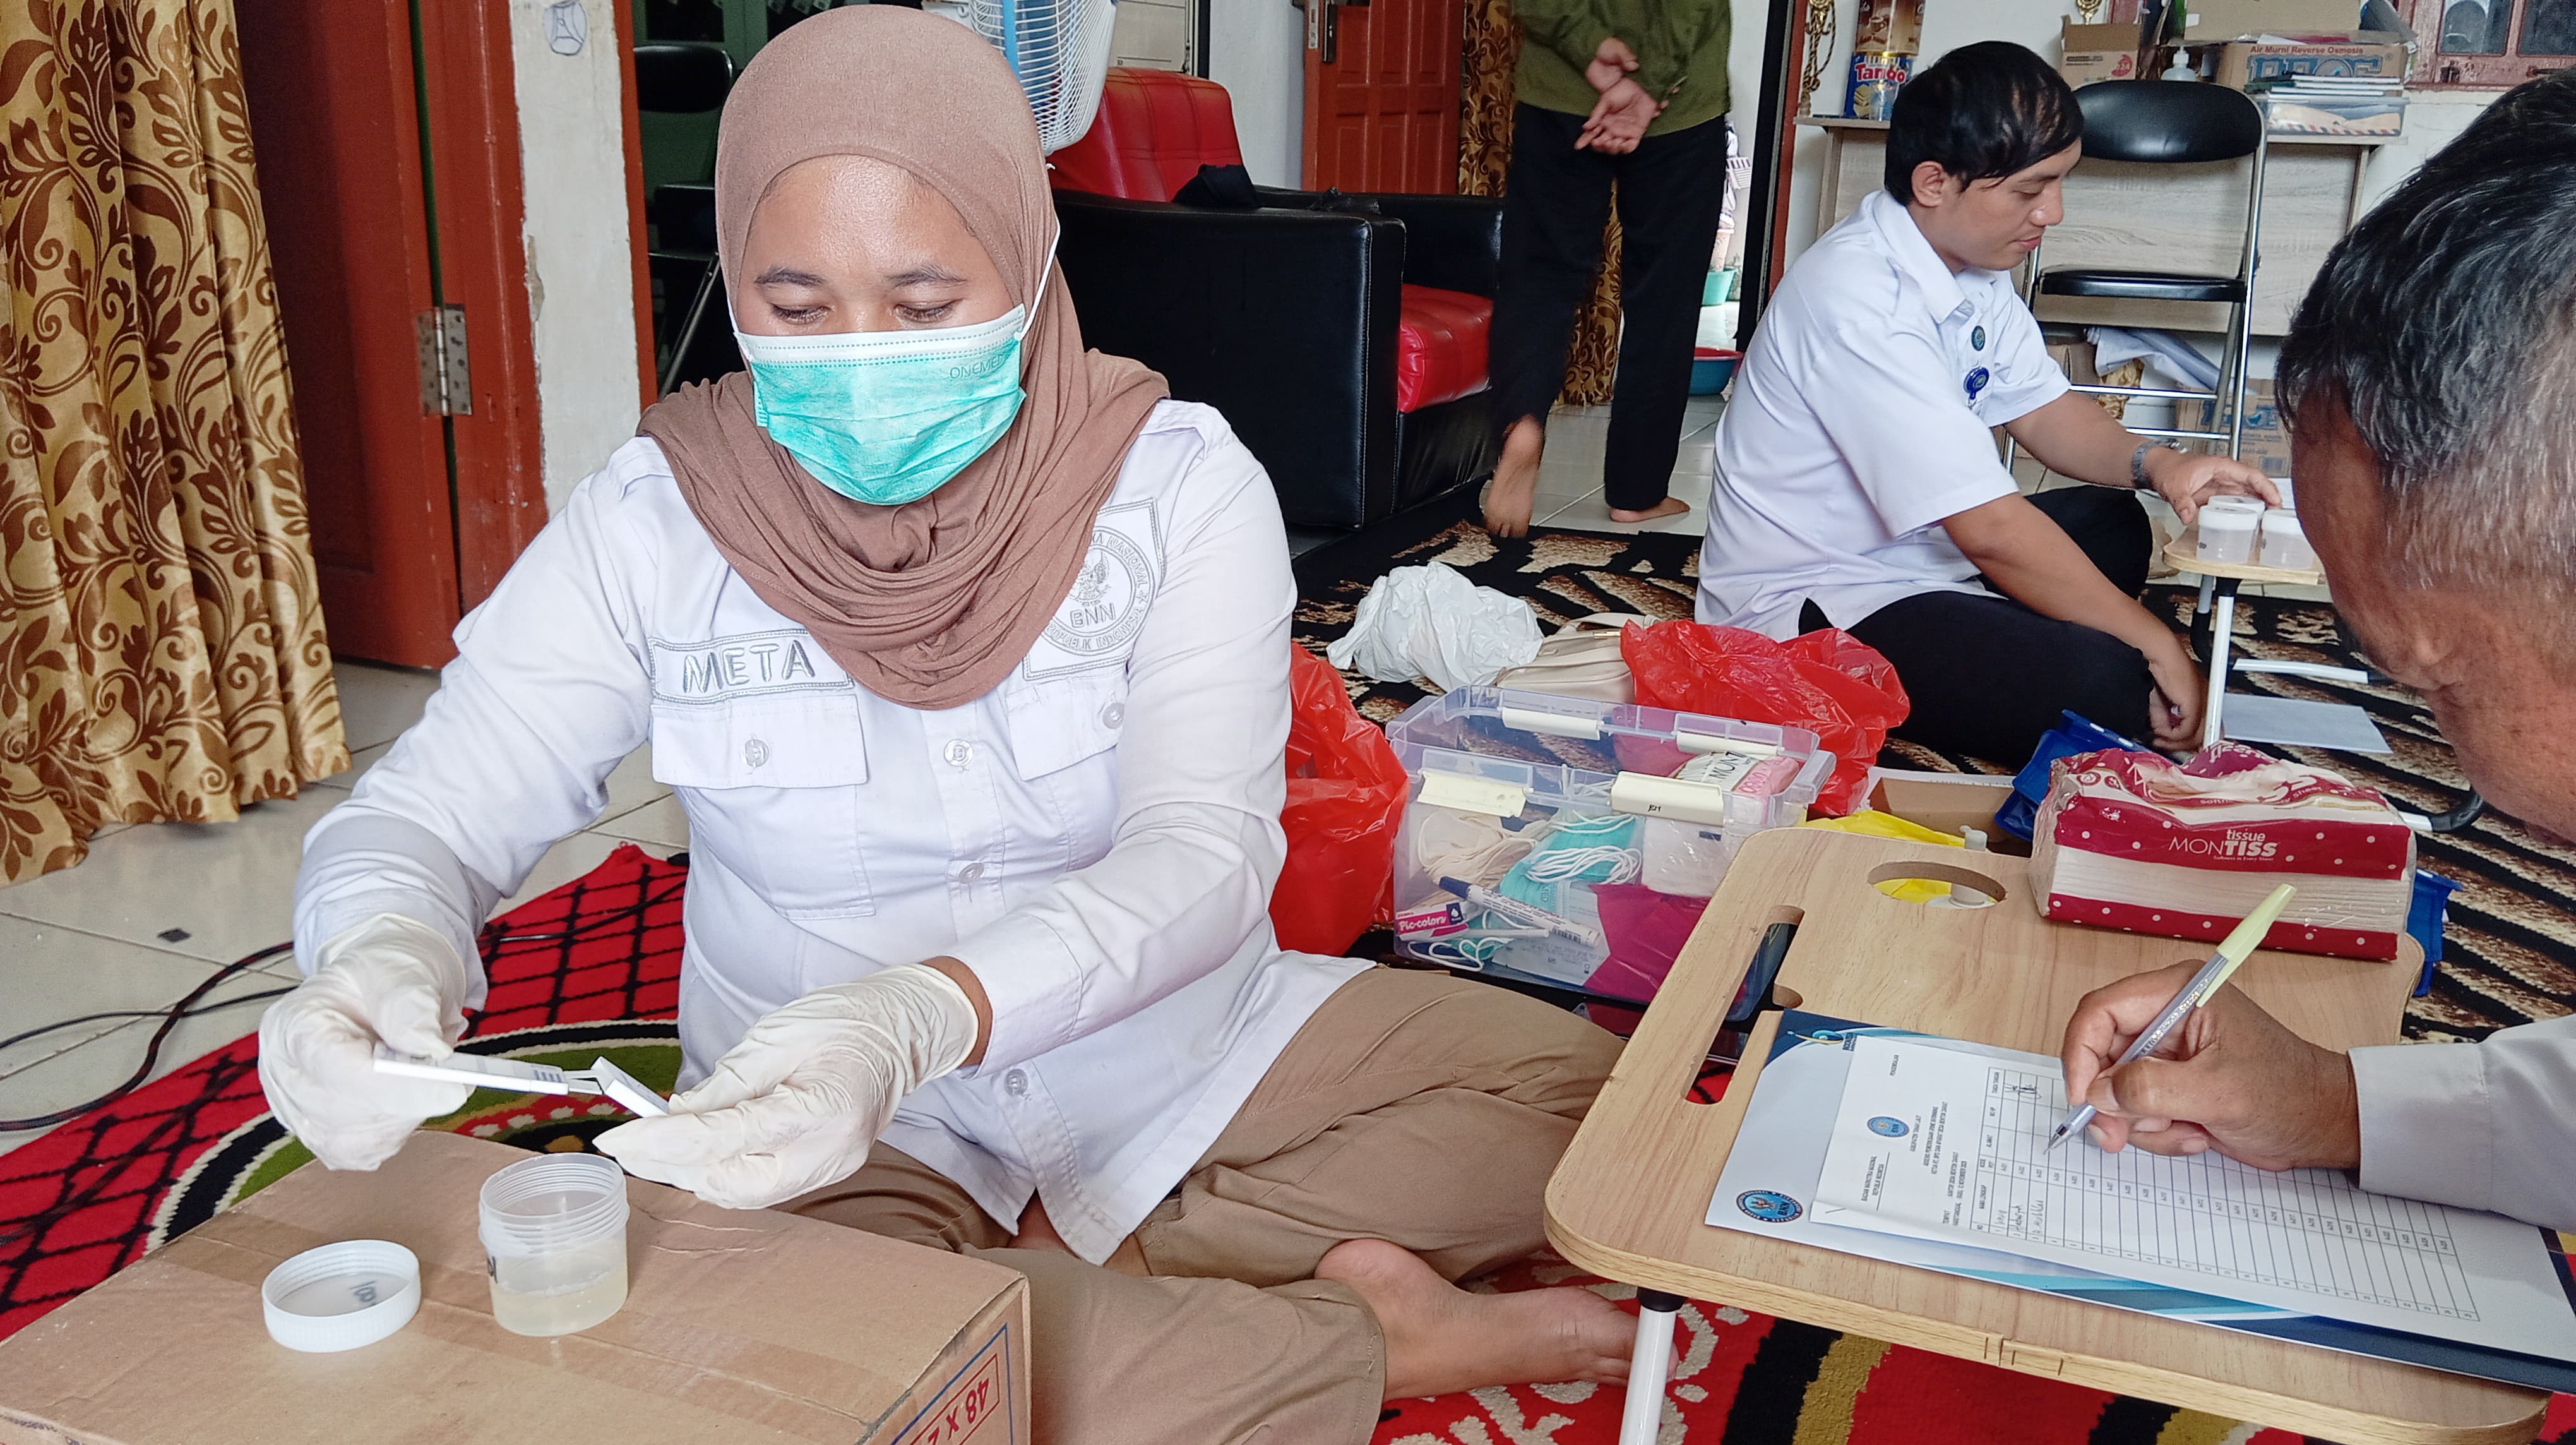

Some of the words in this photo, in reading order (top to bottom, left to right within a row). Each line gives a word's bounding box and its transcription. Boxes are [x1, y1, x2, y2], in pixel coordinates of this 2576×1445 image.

[1107, 536, 1148, 589] NASIONAL
[1070, 602, 1116, 628] BNN
[1095, 607, 1145, 649] INDONESIA
[682, 639, 816, 693] META
[2168, 836, 2278, 858] MONTISS
[2226, 828, 2266, 842] tissue
[965, 1377, 990, 1424] 48
